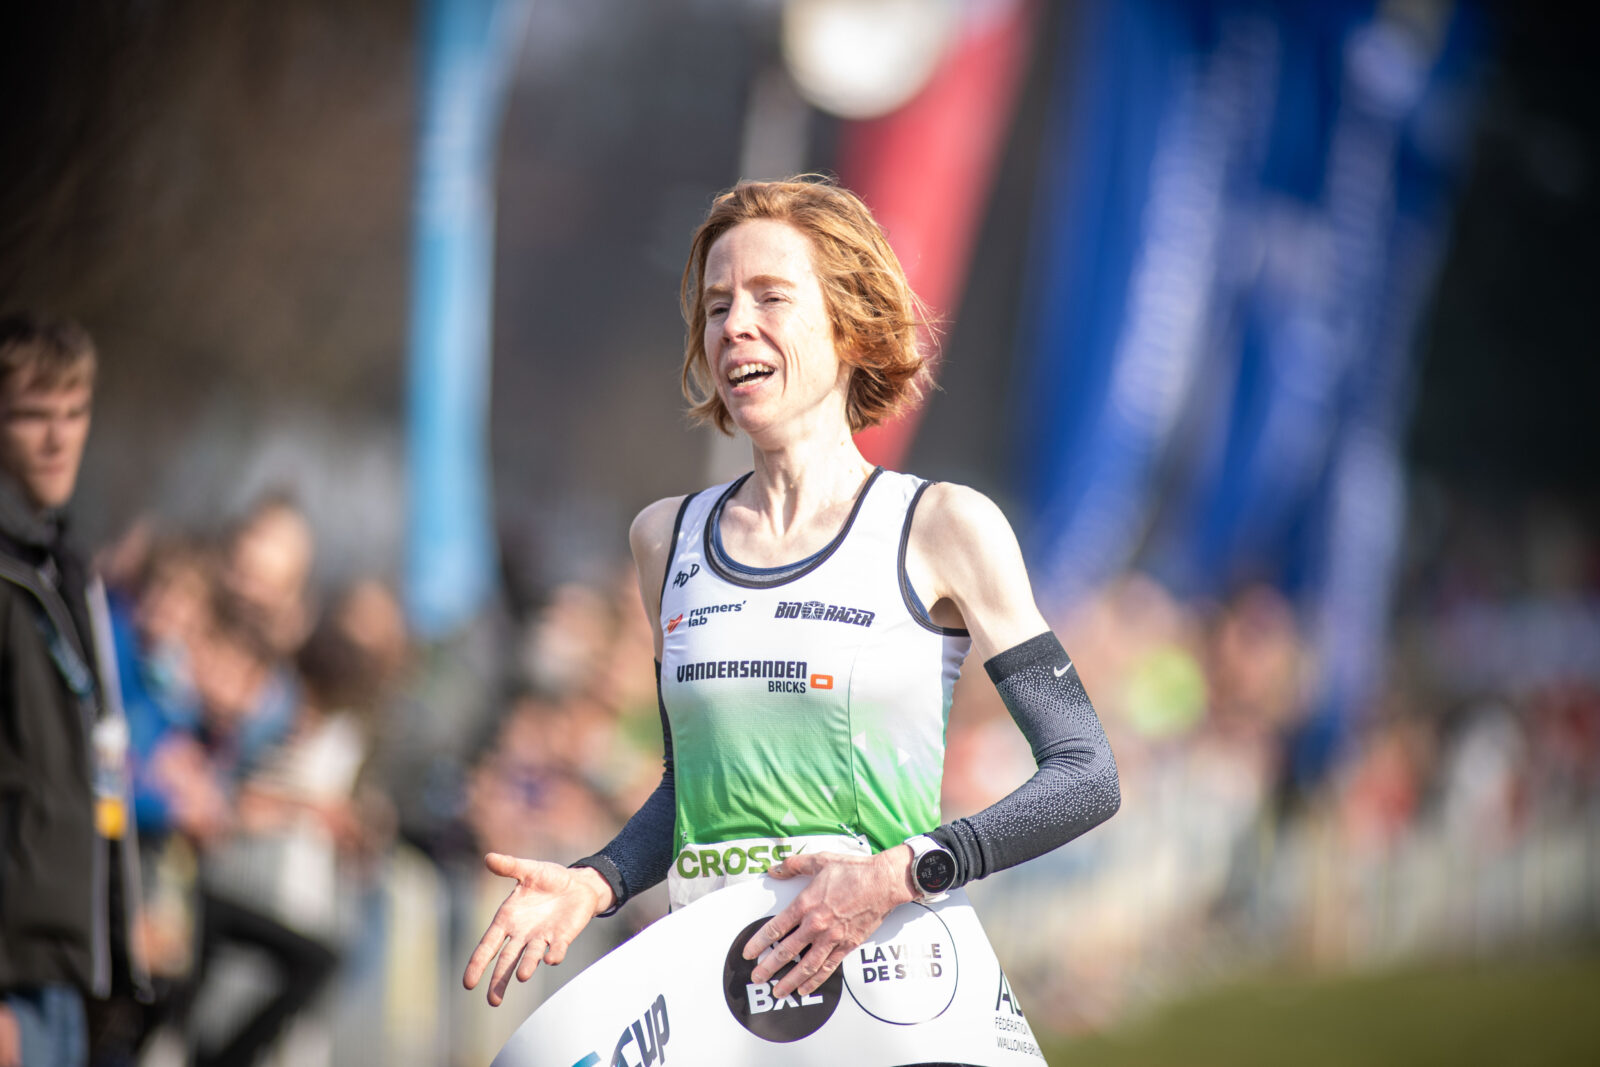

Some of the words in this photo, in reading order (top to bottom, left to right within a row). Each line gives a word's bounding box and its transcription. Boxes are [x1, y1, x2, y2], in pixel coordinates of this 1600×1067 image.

[688, 616, 708, 627] lab
[676, 660, 807, 683] VANDERSANDEN
[768, 681, 806, 693] BRICKS
[860, 946, 887, 964] LA
[863, 965, 890, 984] DE
[894, 962, 943, 980] SD
